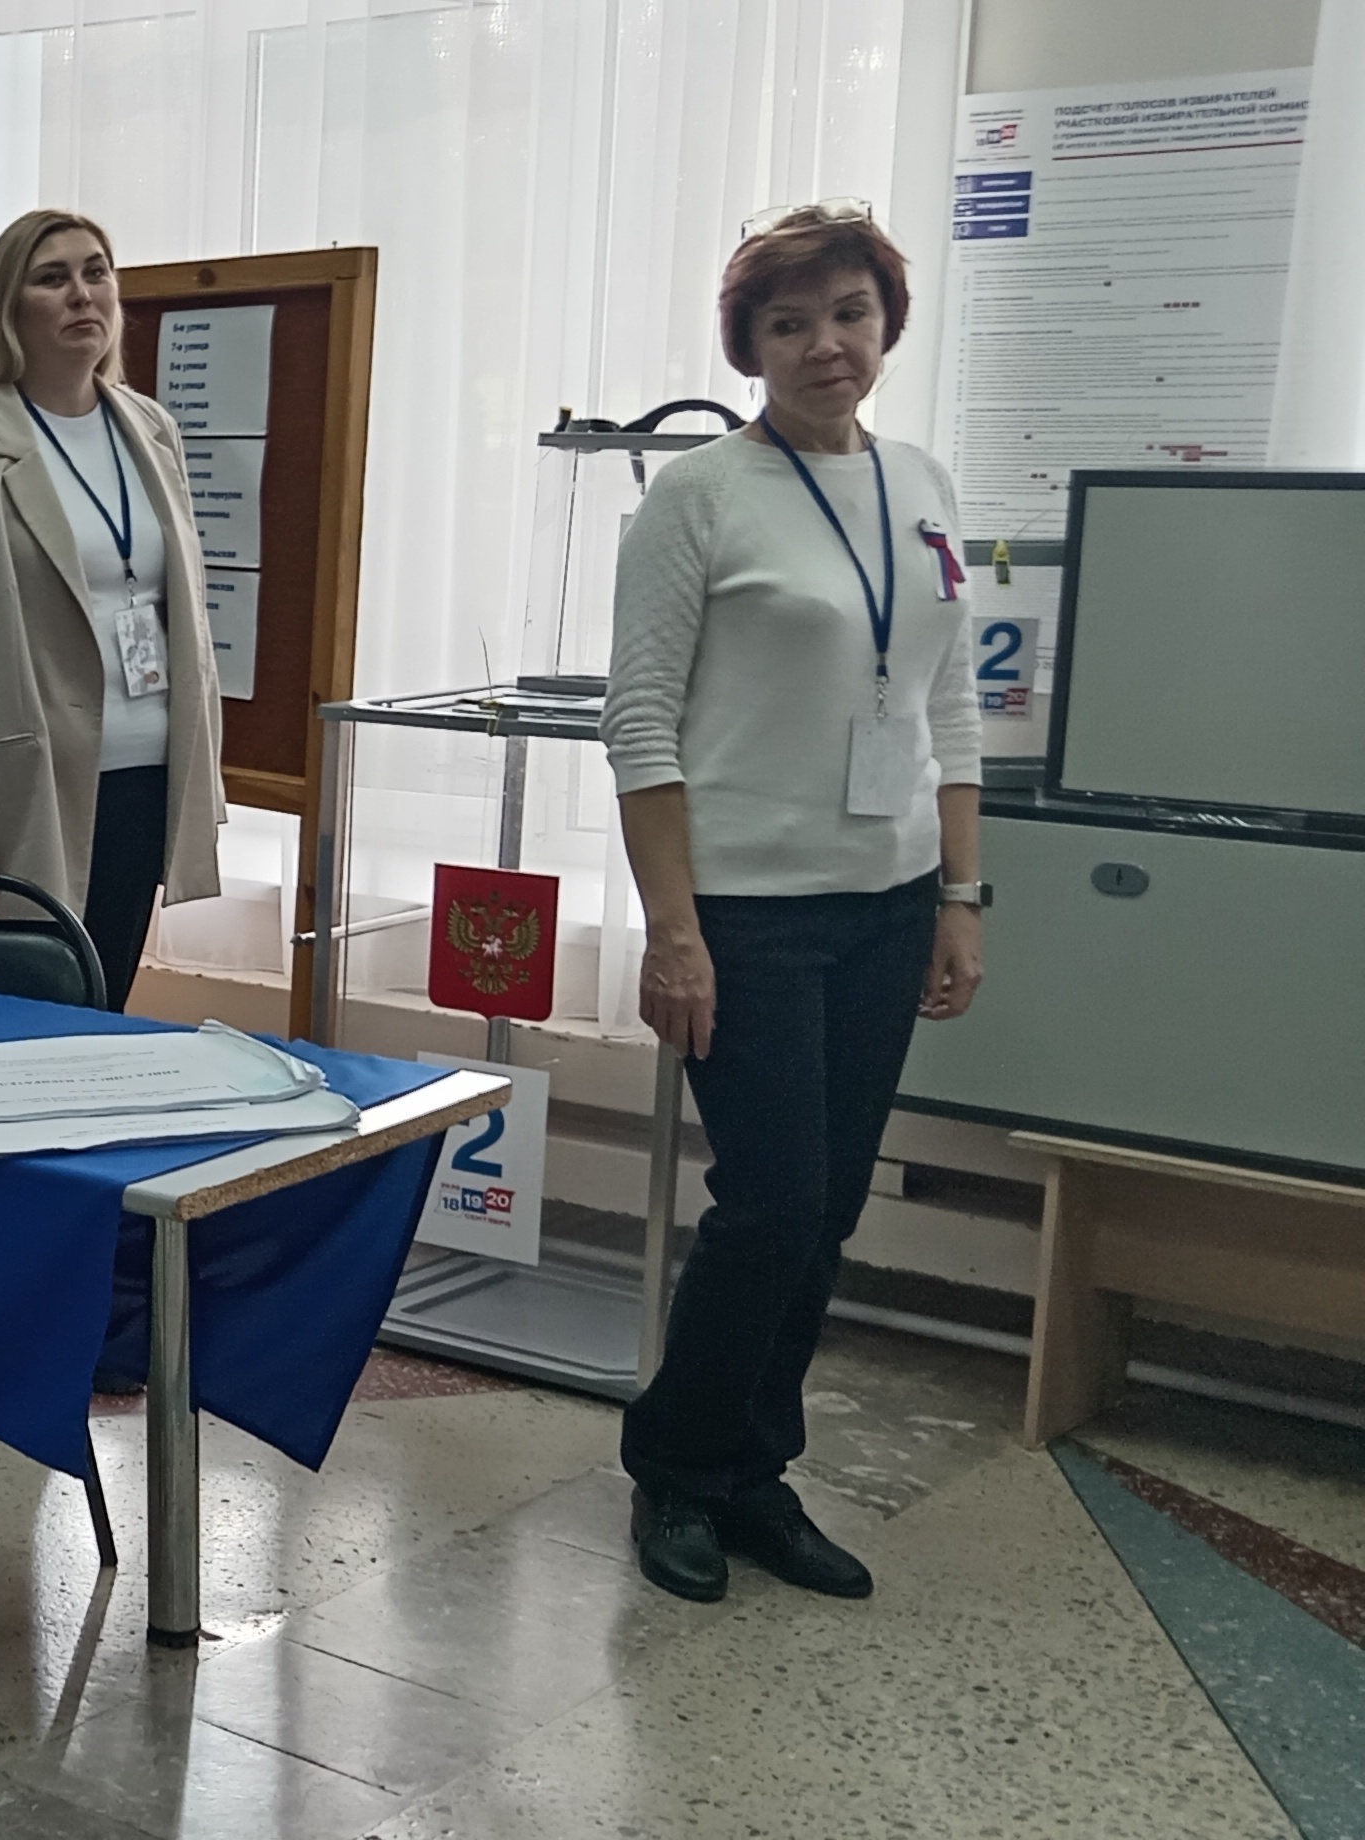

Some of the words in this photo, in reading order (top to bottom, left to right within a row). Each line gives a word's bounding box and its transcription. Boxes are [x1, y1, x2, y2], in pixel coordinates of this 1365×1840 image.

[1179, 87, 1276, 106] ИЗБИРАТЕЛЕЙ
[976, 622, 1022, 680] 2
[451, 1109, 505, 1178] 2
[442, 1196, 459, 1211] 18
[464, 1193, 482, 1209] 19
[486, 1192, 509, 1208] 20
